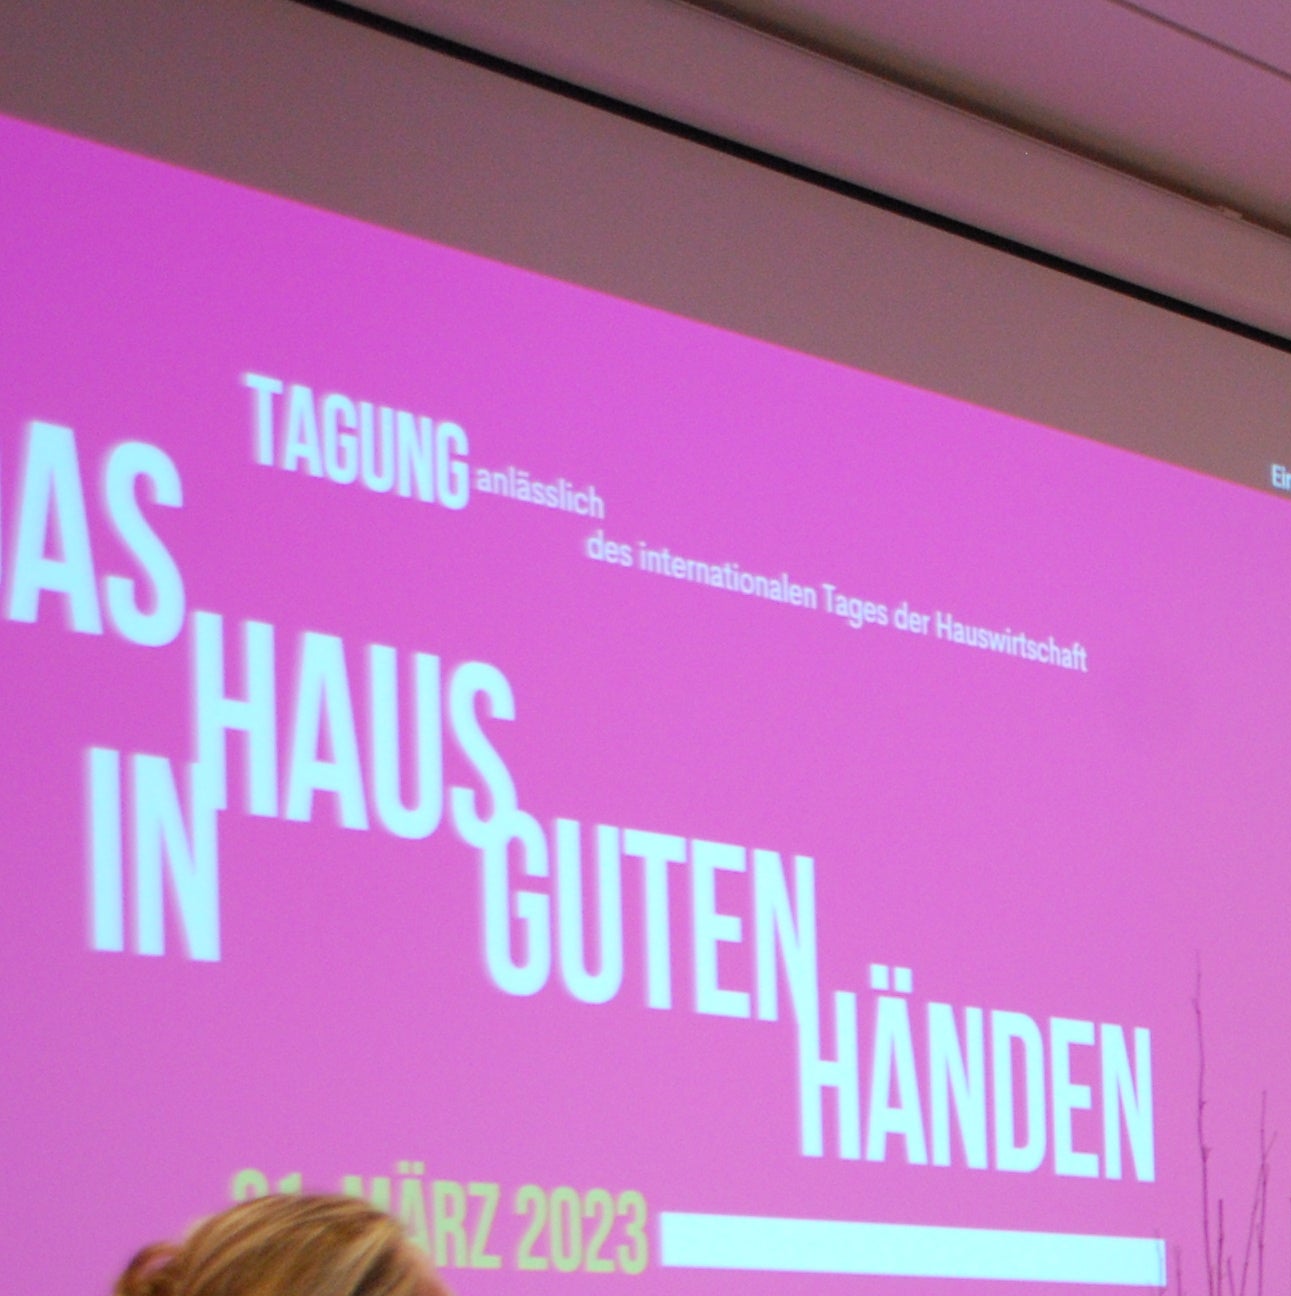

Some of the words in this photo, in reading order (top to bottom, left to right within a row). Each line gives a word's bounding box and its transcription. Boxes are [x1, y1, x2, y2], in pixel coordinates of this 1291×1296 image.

[0, 419, 186, 648] AS
[243, 371, 470, 510] TAGUNG
[476, 466, 606, 520] anlässlich
[586, 528, 634, 568] des
[638, 541, 818, 610] internationalen
[822, 582, 890, 629] Tages
[894, 602, 932, 636] der
[935, 610, 1090, 673] Hauswirtschaft
[192, 610, 517, 850] HAUS
[87, 746, 222, 963] IN
[483, 808, 819, 1023] GUTEN
[799, 962, 1156, 1183] HÄNDEN
[341, 1161, 500, 1270] ÄRZ
[515, 1183, 649, 1276] 2023
